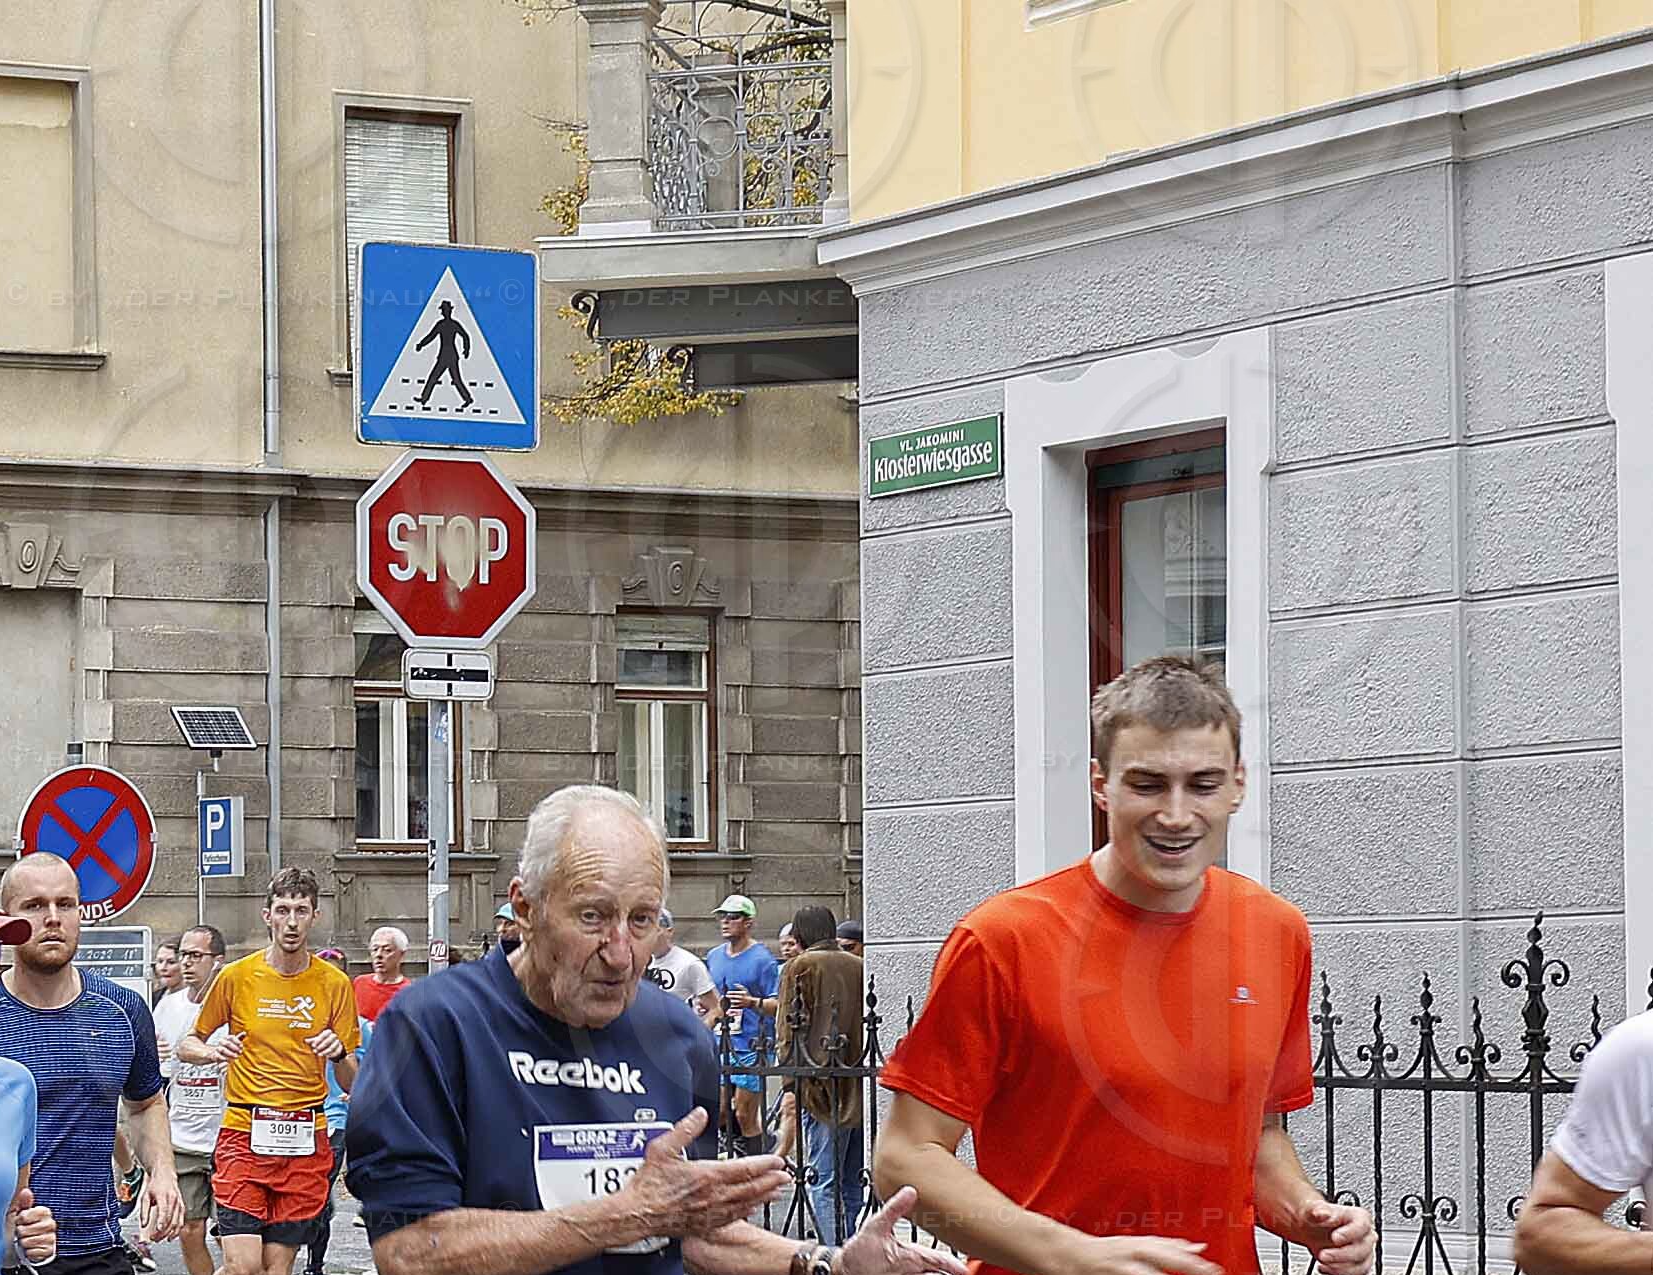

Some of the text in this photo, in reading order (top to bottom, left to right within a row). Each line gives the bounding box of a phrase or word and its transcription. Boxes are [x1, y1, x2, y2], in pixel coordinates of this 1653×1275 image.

[899, 428, 965, 452] VL. JAKOMINI
[873, 440, 994, 483] Klosterwiesgasse
[388, 512, 508, 586] STOP
[207, 804, 225, 849] P
[77, 899, 116, 921] NDE
[508, 1051, 647, 1095] Reebok
[270, 1123, 298, 1135] 3091
[576, 1131, 618, 1146] GRAZ
